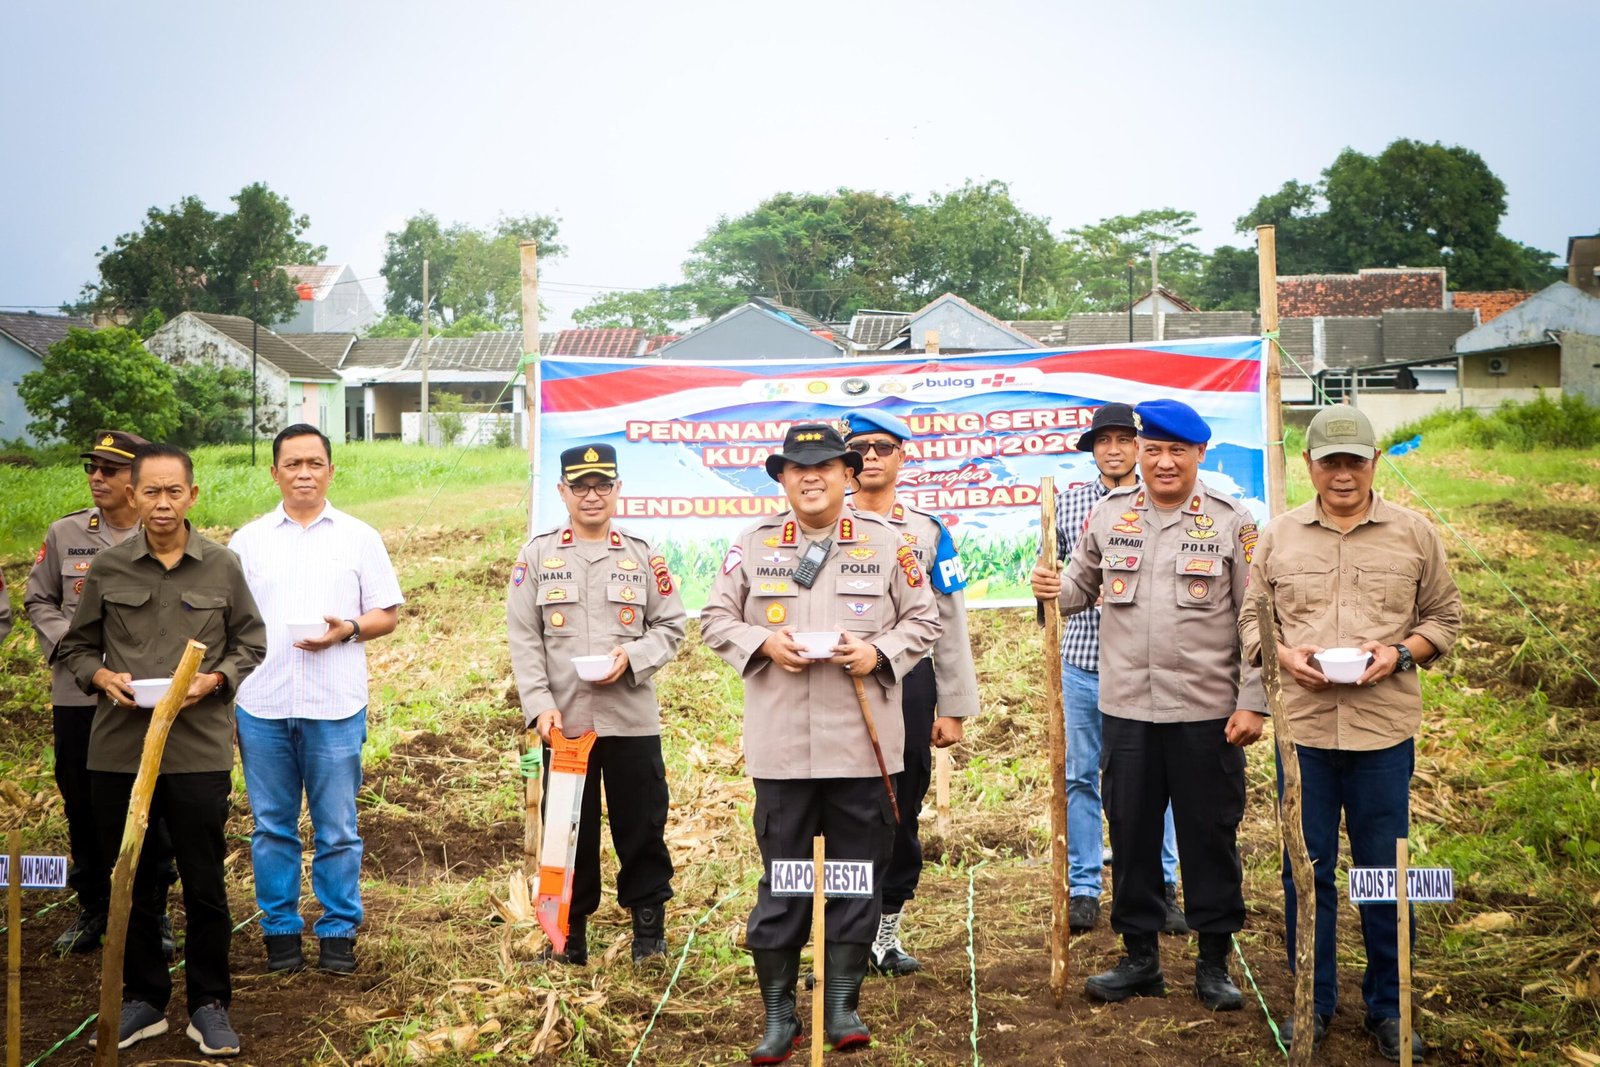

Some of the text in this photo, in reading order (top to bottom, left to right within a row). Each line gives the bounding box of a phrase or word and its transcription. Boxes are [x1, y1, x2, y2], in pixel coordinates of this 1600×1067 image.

[926, 377, 975, 388] bulog
[629, 407, 1098, 440] PENANAM UNG SEREN
[706, 447, 784, 465] KUA
[903, 438, 993, 458] AHUN
[896, 465, 987, 487] Rangka
[616, 486, 1043, 516] ENDUKUN SEMBAD
[1108, 537, 1143, 549] AKMADI
[1181, 543, 1219, 553] POLRI
[611, 573, 643, 583] POLRI
[840, 563, 881, 574] POLRI
[35, 858, 64, 885] PANGAN
[774, 863, 868, 891] KAPORESTA
[1350, 870, 1451, 898] KADIS PTANIAN
